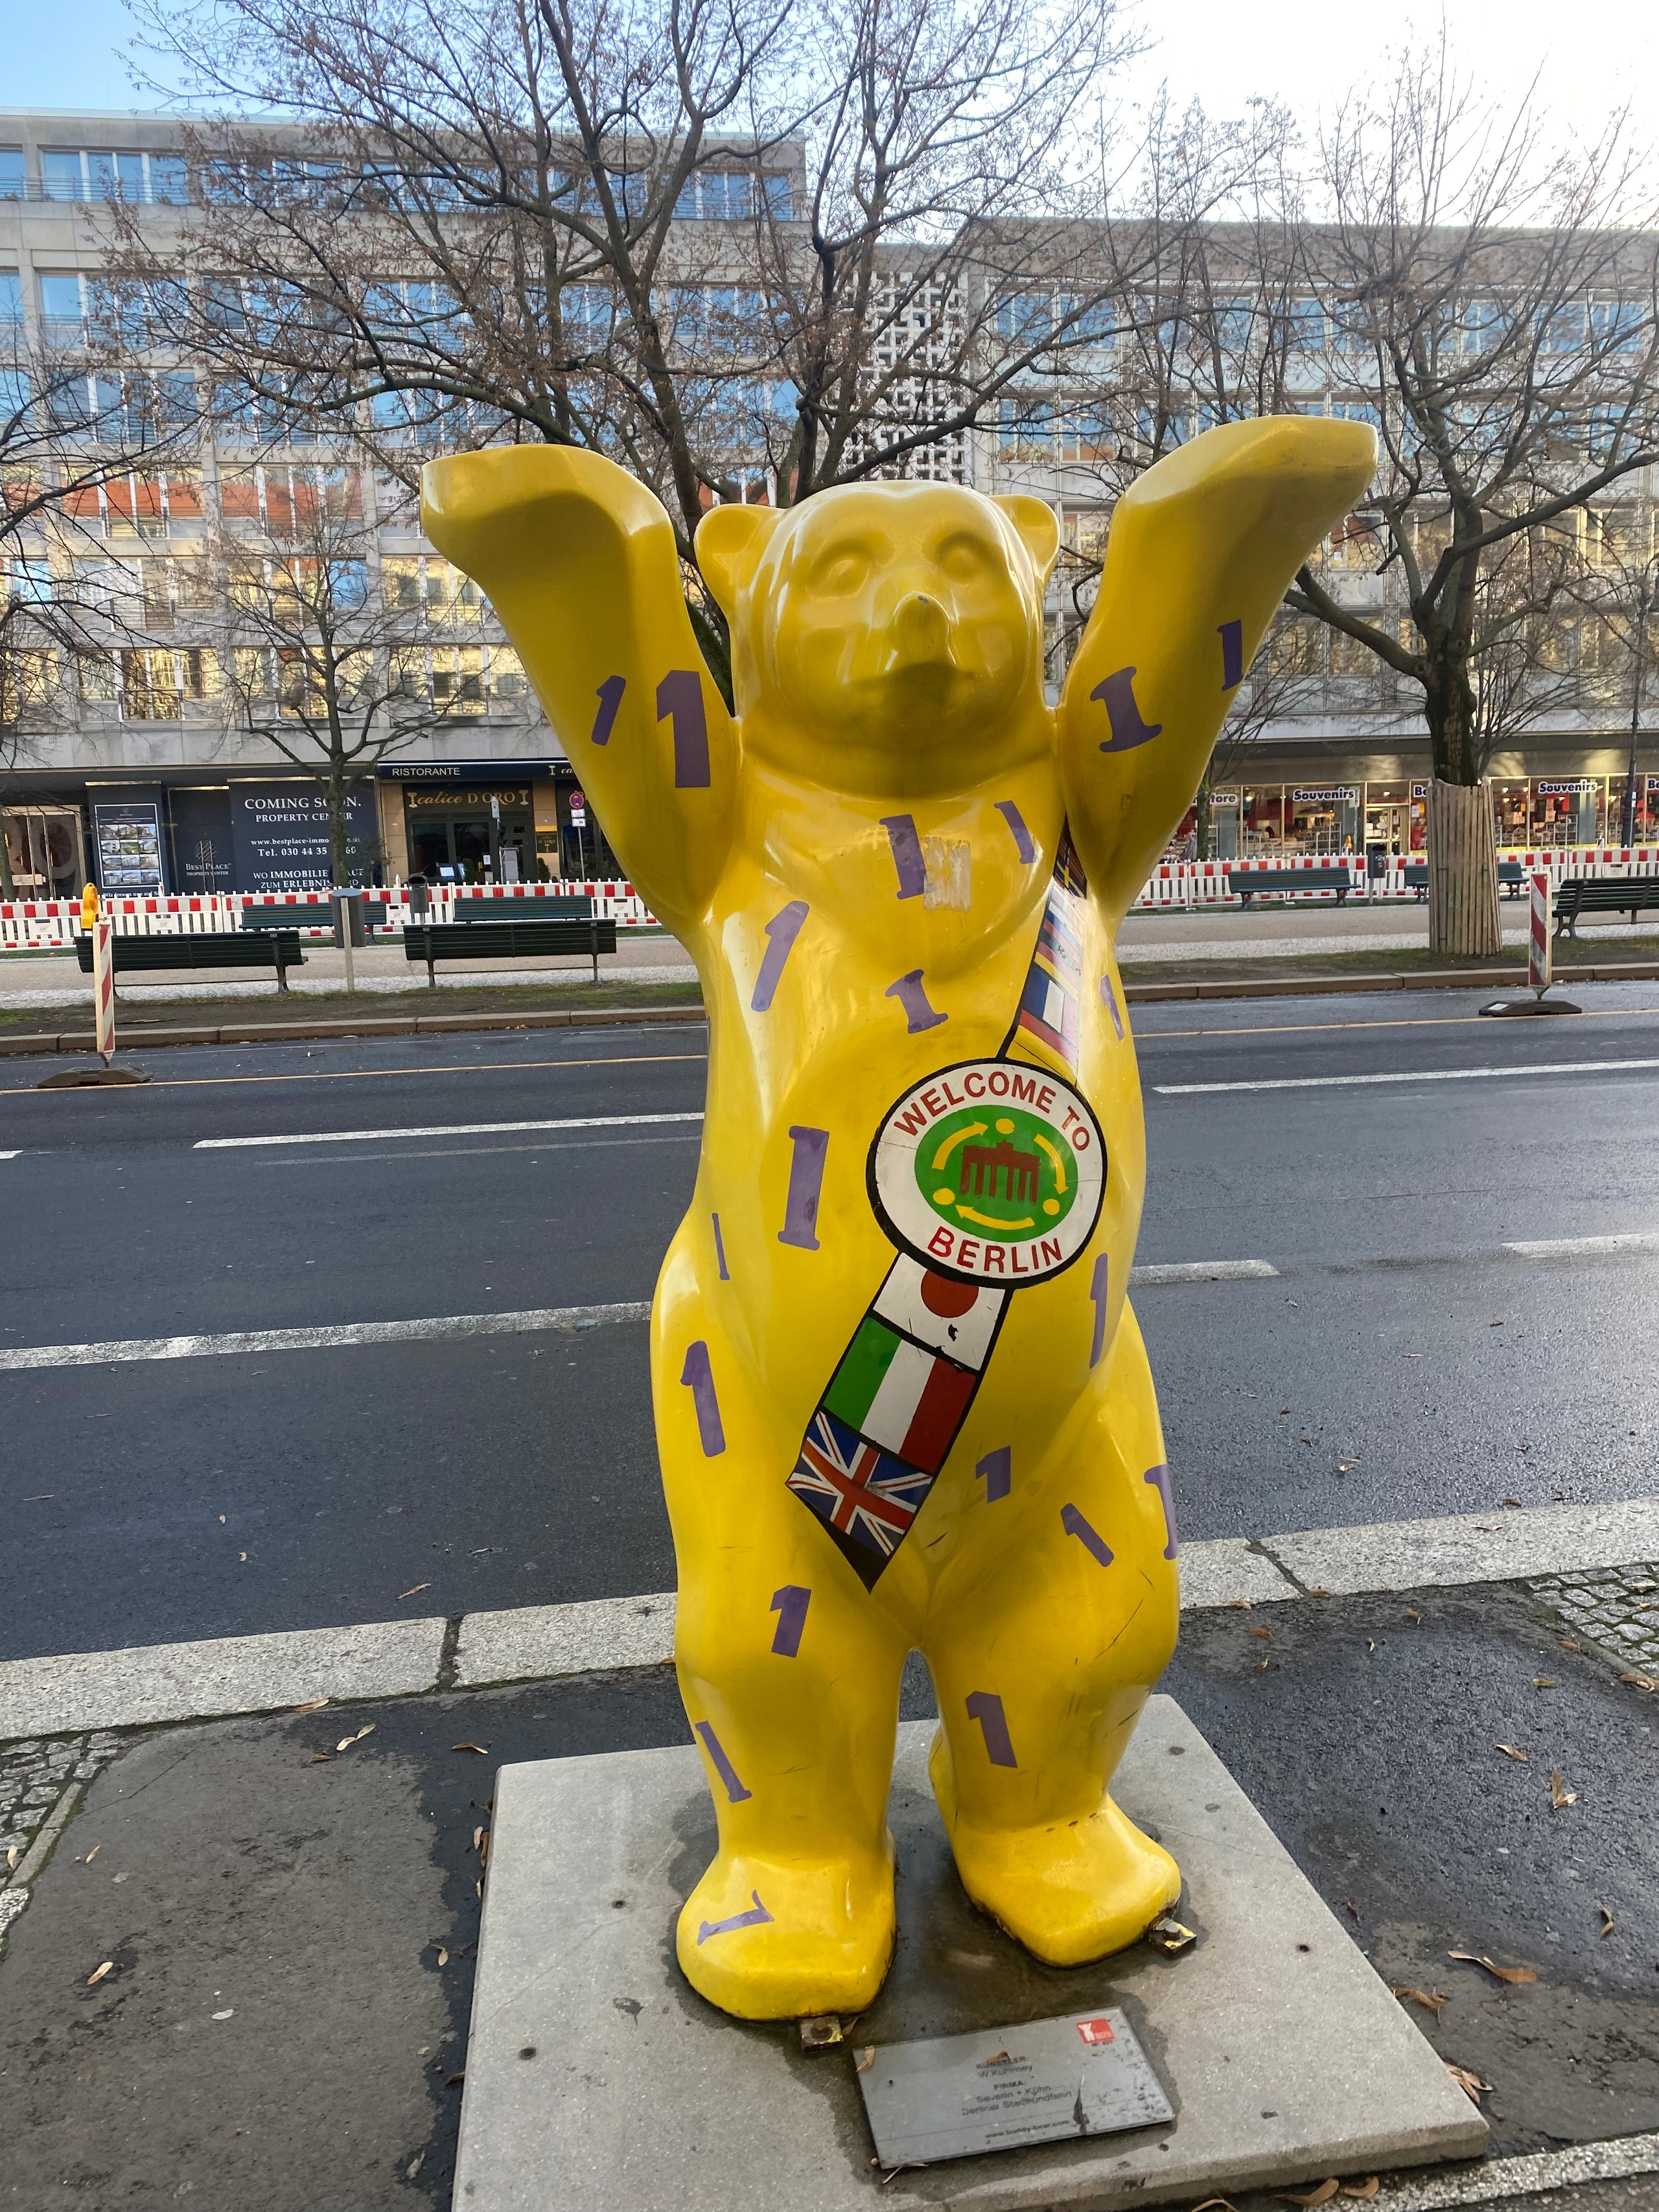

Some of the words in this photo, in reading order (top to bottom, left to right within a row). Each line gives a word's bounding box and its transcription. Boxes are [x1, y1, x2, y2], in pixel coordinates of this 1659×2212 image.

[591, 675, 626, 745] 1
[657, 671, 710, 788] 1
[1090, 666, 1162, 752] 1
[392, 767, 461, 776] RISTORANTE
[417, 791, 463, 804] calice
[1210, 794, 1236, 803] tore
[1294, 788, 1354, 800] Souvenirs
[1539, 781, 1597, 793] Souvenirs
[244, 798, 310, 809] COMING
[255, 814, 309, 822] PROPERTY
[258, 848, 278, 857] Tel.
[281, 848, 298, 856] 030
[301, 847, 313, 856] 44
[316, 846, 327, 855] 35
[751, 902, 809, 1013] 1
[885, 968, 949, 1034] 1
[893, 1071, 1056, 1136] WELCOME
[1061, 1104, 1090, 1151] TO
[927, 1226, 1063, 1274] BERLIN
[680, 1340, 726, 1458] 1
[975, 1446, 1012, 1503] 1
[1061, 1503, 1115, 1568] 1
[770, 1584, 812, 1659] 1
[966, 1691, 1019, 1769] 1
